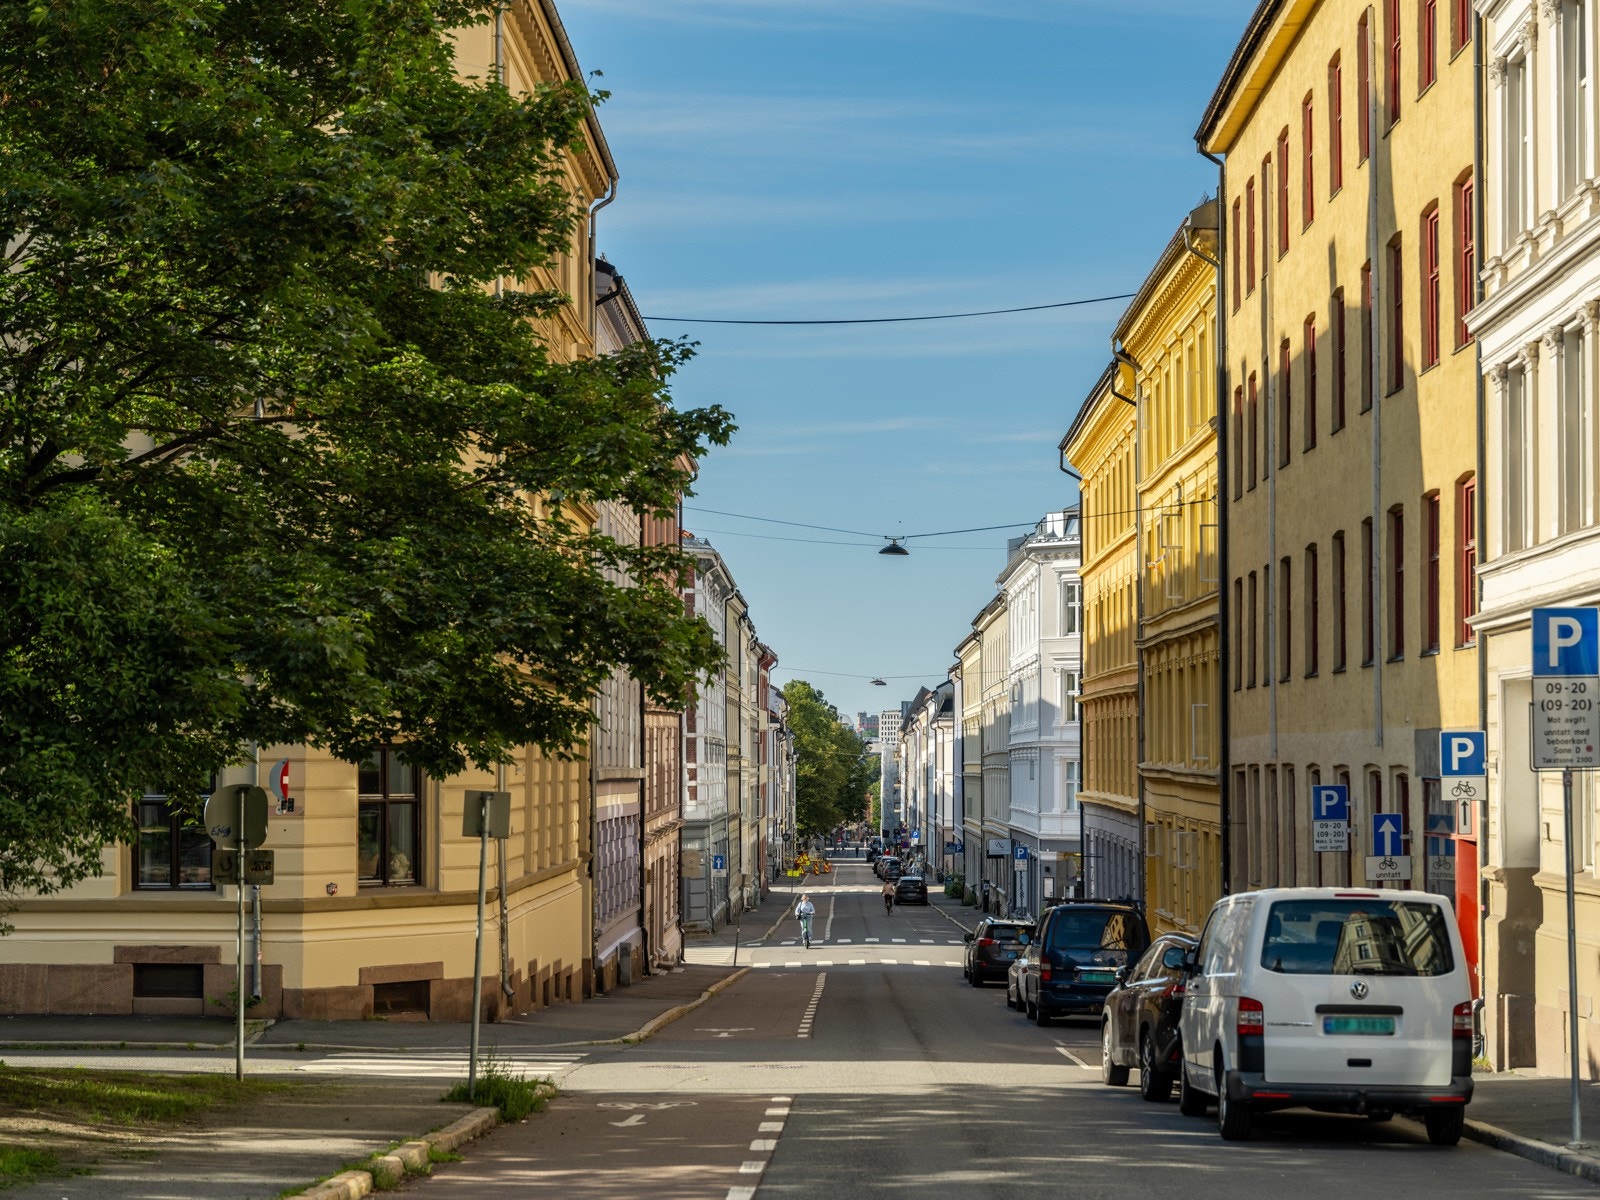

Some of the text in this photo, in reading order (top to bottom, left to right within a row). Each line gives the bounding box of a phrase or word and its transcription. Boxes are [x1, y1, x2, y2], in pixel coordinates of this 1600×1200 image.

[1549, 616, 1583, 667] P
[1564, 716, 1586, 725] avgift
[1574, 728, 1590, 736] med
[1451, 737, 1475, 771] P
[1321, 790, 1339, 816] P
[1017, 848, 1025, 858] P
